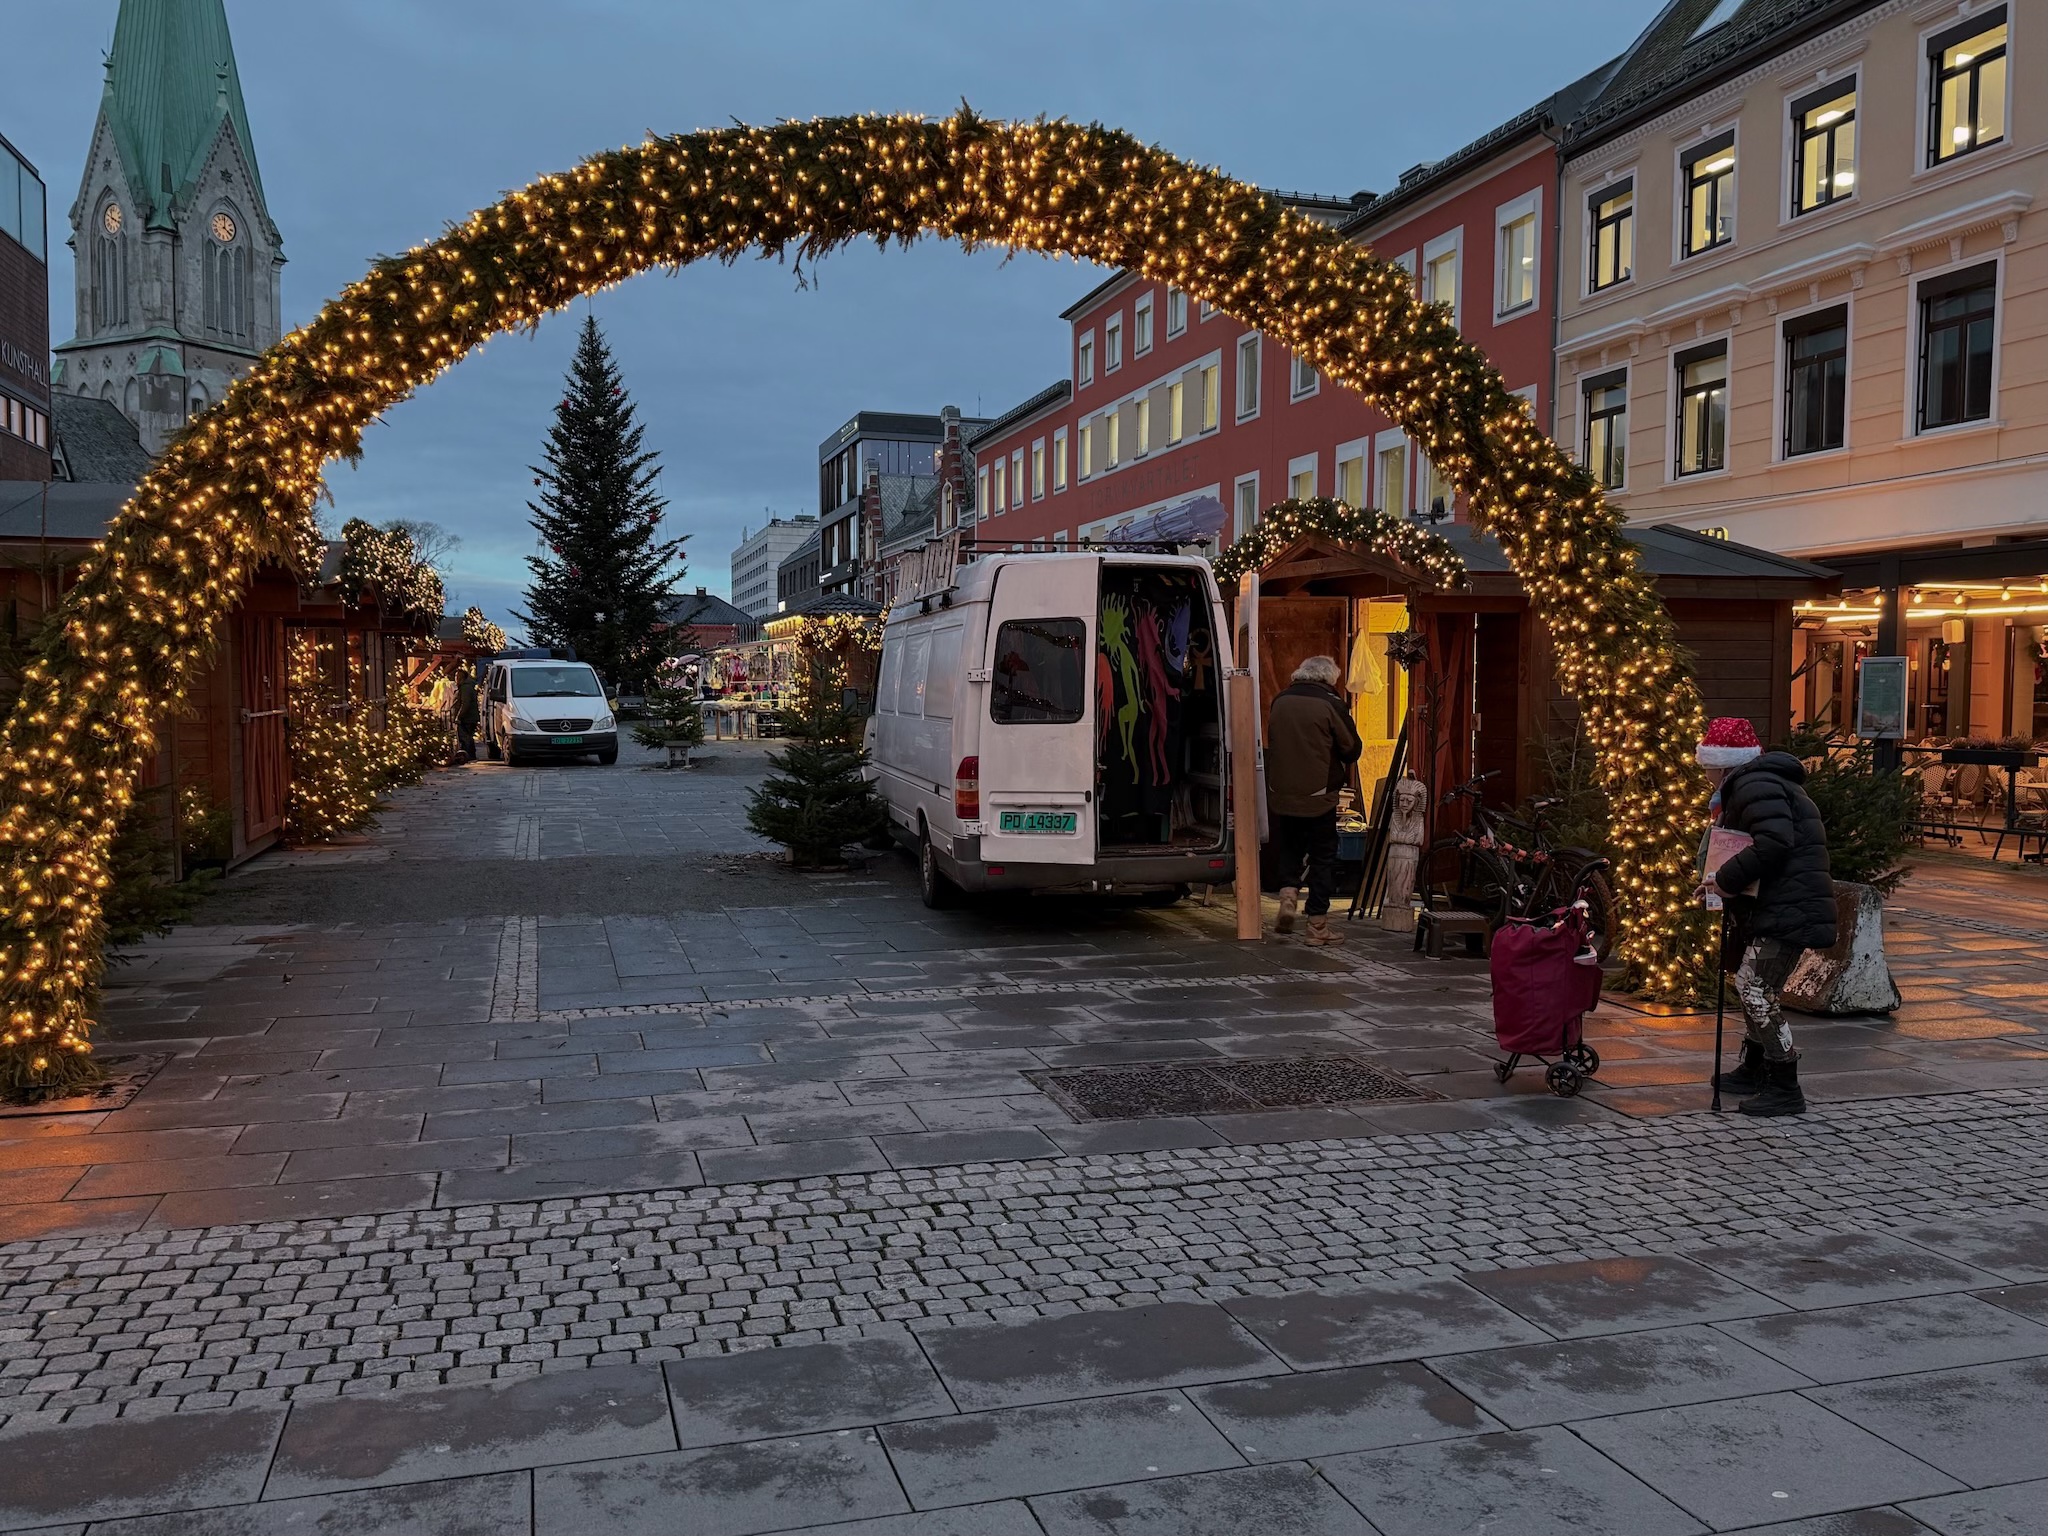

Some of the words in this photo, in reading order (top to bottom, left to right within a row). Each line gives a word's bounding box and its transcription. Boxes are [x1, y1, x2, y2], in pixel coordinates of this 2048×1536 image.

[1, 339, 47, 388] KUNSTHALL
[1004, 815, 1021, 828] PD
[1028, 815, 1071, 829] 14337
